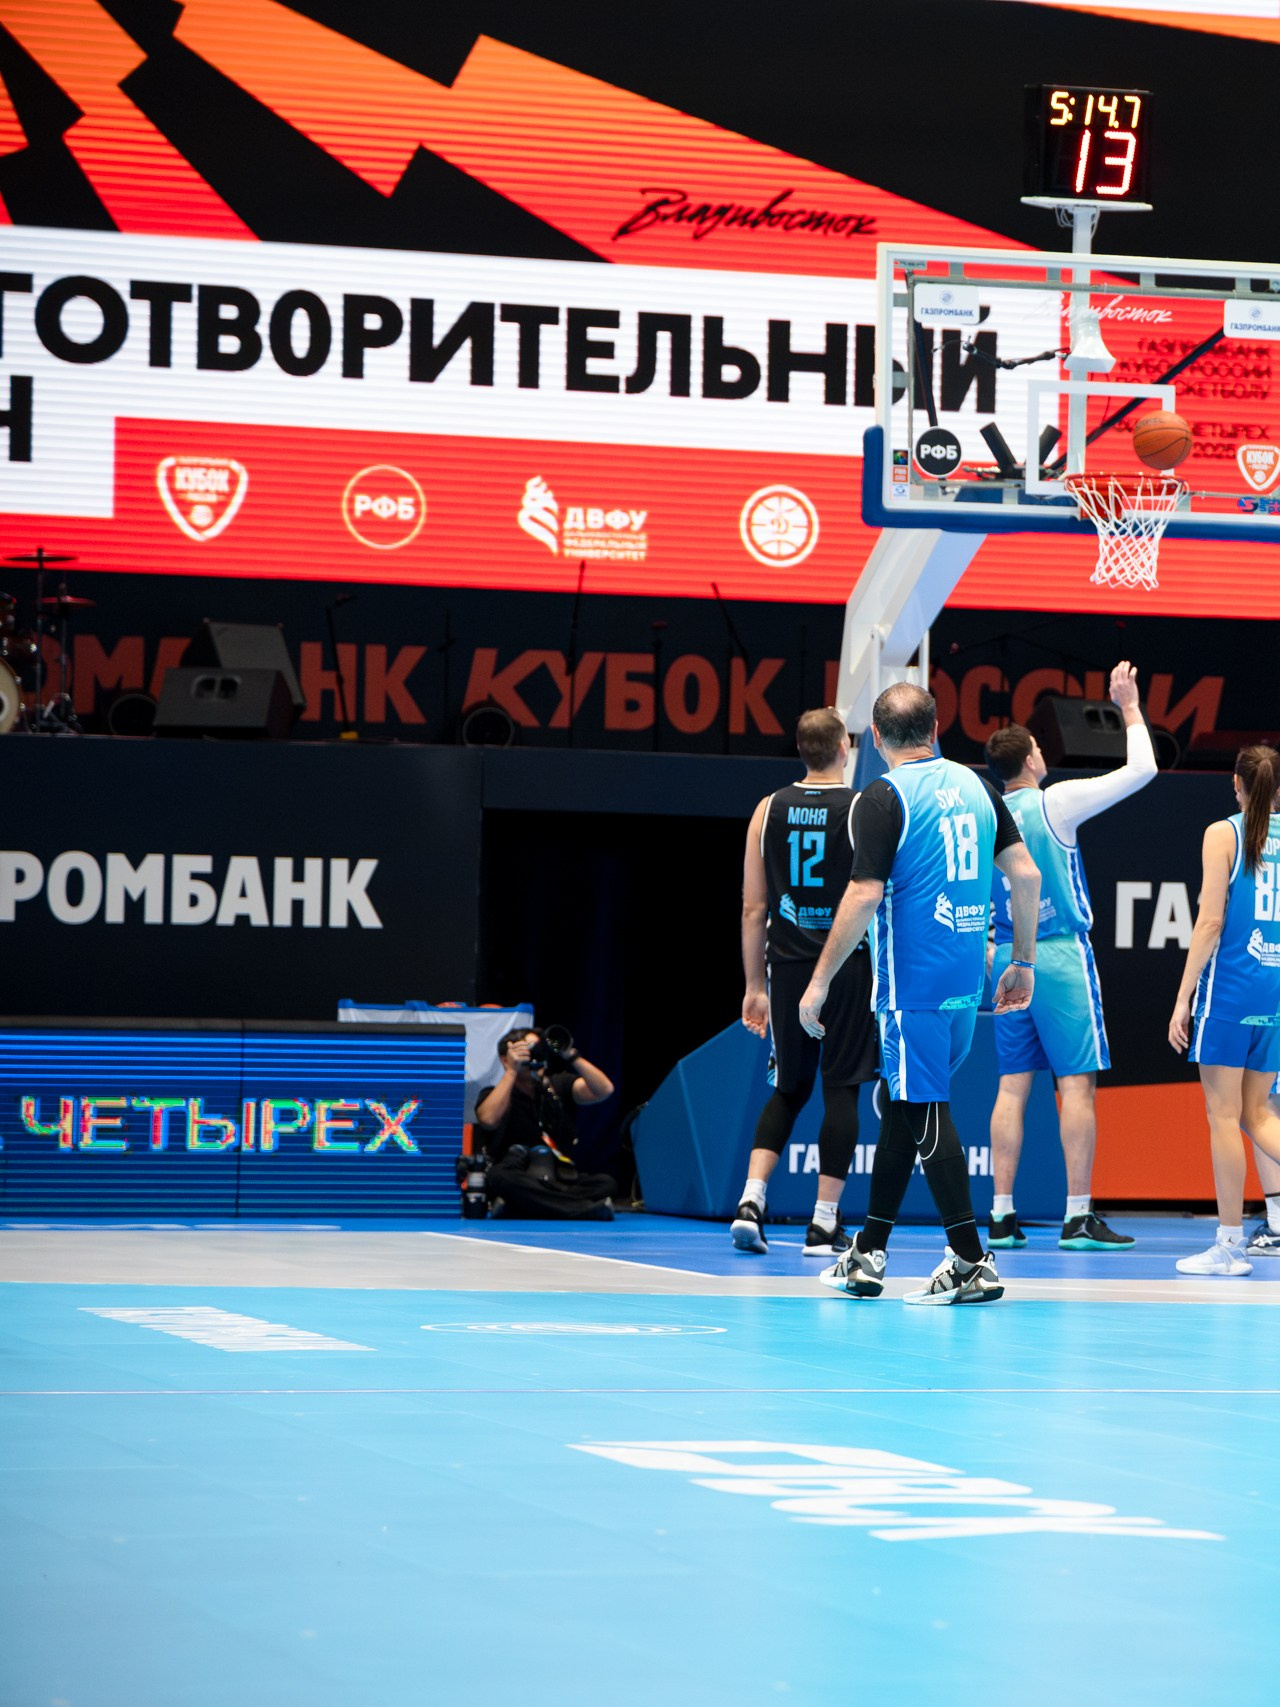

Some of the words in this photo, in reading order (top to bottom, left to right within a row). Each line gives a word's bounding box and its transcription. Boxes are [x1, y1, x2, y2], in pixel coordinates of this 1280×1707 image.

[1050, 91, 1141, 129] 5:14.7
[1075, 129, 1137, 195] 13
[611, 188, 879, 241] Владивосток
[920, 306, 975, 318] ГАЗПРОМБАНК
[920, 444, 958, 460] РФБ
[353, 493, 417, 521] РФБ
[563, 507, 648, 531] ДВФУ
[460, 646, 787, 735] КУБОК
[787, 806, 828, 826] МОНЯ
[787, 830, 826, 887] 12
[938, 813, 979, 883] 18
[798, 906, 833, 917] ДВФУ
[955, 904, 985, 918] ДВФУ
[21, 1096, 422, 1152] ЧЕТЫРЕХ
